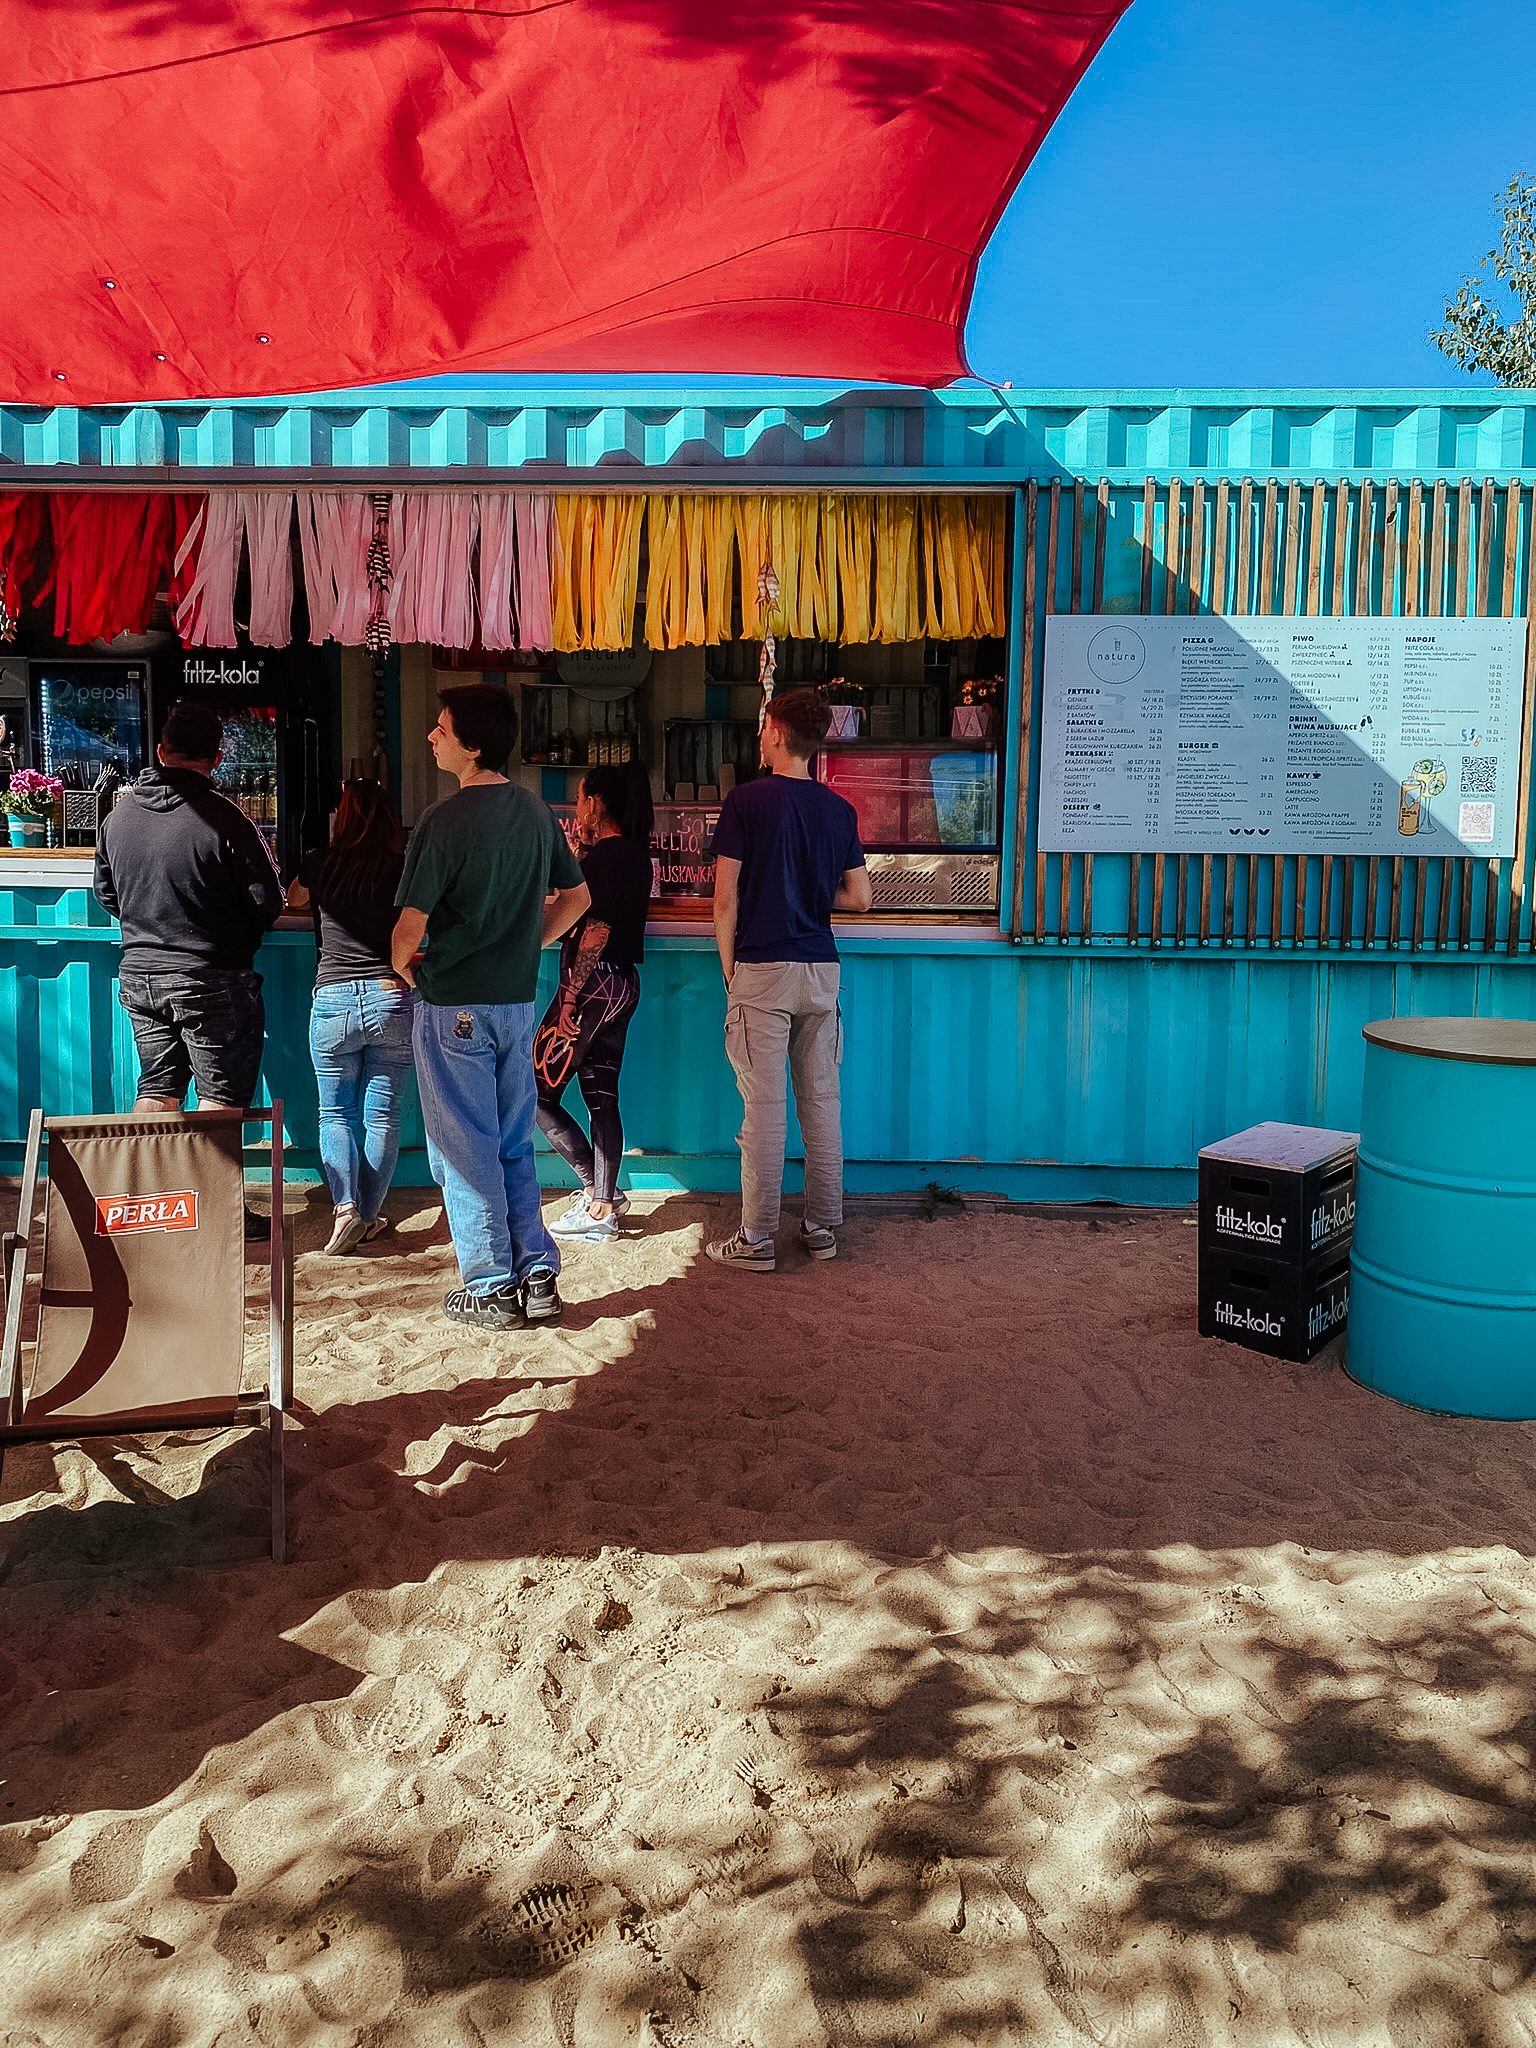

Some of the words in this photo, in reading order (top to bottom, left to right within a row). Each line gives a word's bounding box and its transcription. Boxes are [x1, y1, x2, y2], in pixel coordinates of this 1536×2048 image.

[183, 659, 260, 684] fritz-kola
[77, 684, 130, 703] pepsi
[106, 1199, 189, 1226] PERŁA
[1216, 1205, 1282, 1239] fritz-kola
[1214, 1300, 1281, 1337] fritz-kola
